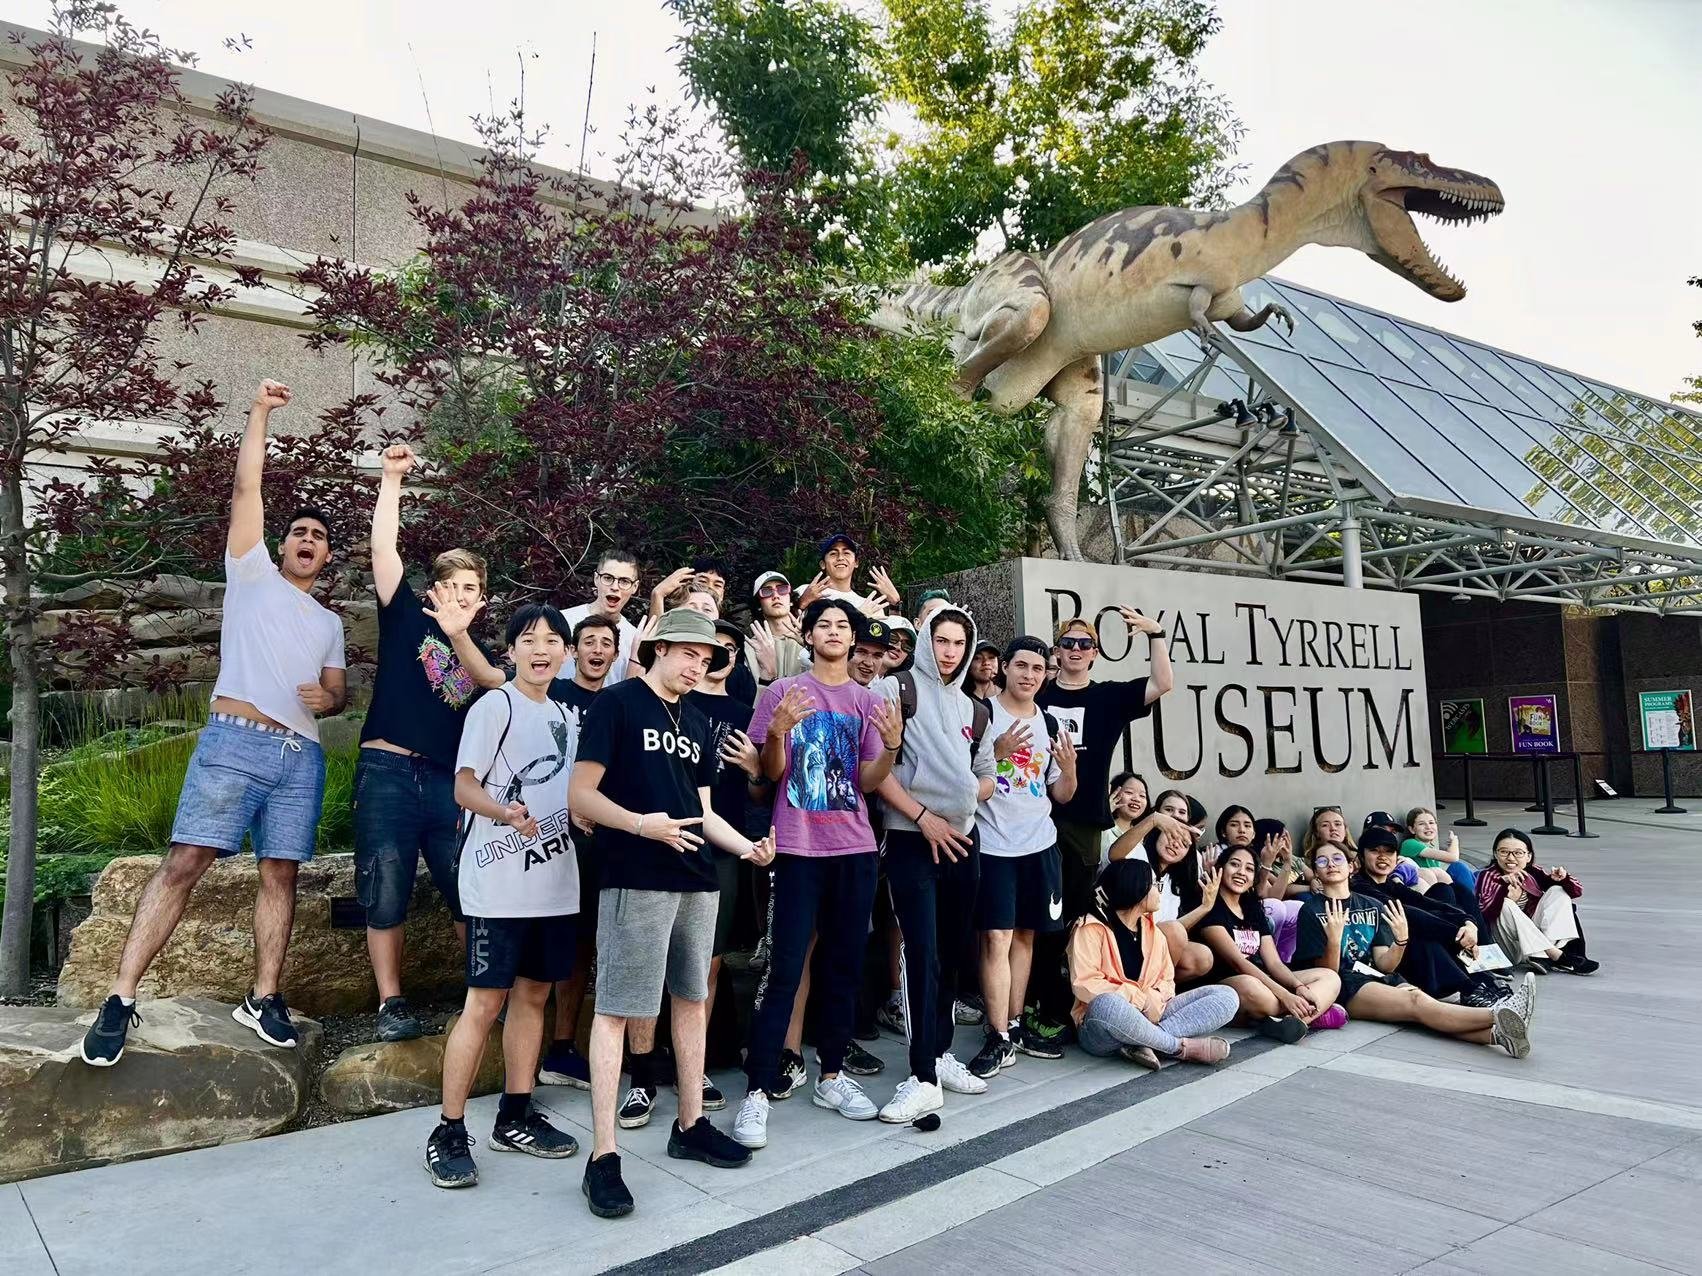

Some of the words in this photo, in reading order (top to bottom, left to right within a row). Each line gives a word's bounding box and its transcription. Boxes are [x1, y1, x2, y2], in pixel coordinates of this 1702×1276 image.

[1235, 602, 1412, 671] TYRRELL
[643, 728, 701, 764] BOSS
[475, 808, 569, 869] UNDER
[1351, 912, 1366, 925] ON
[476, 939, 489, 977] UA
